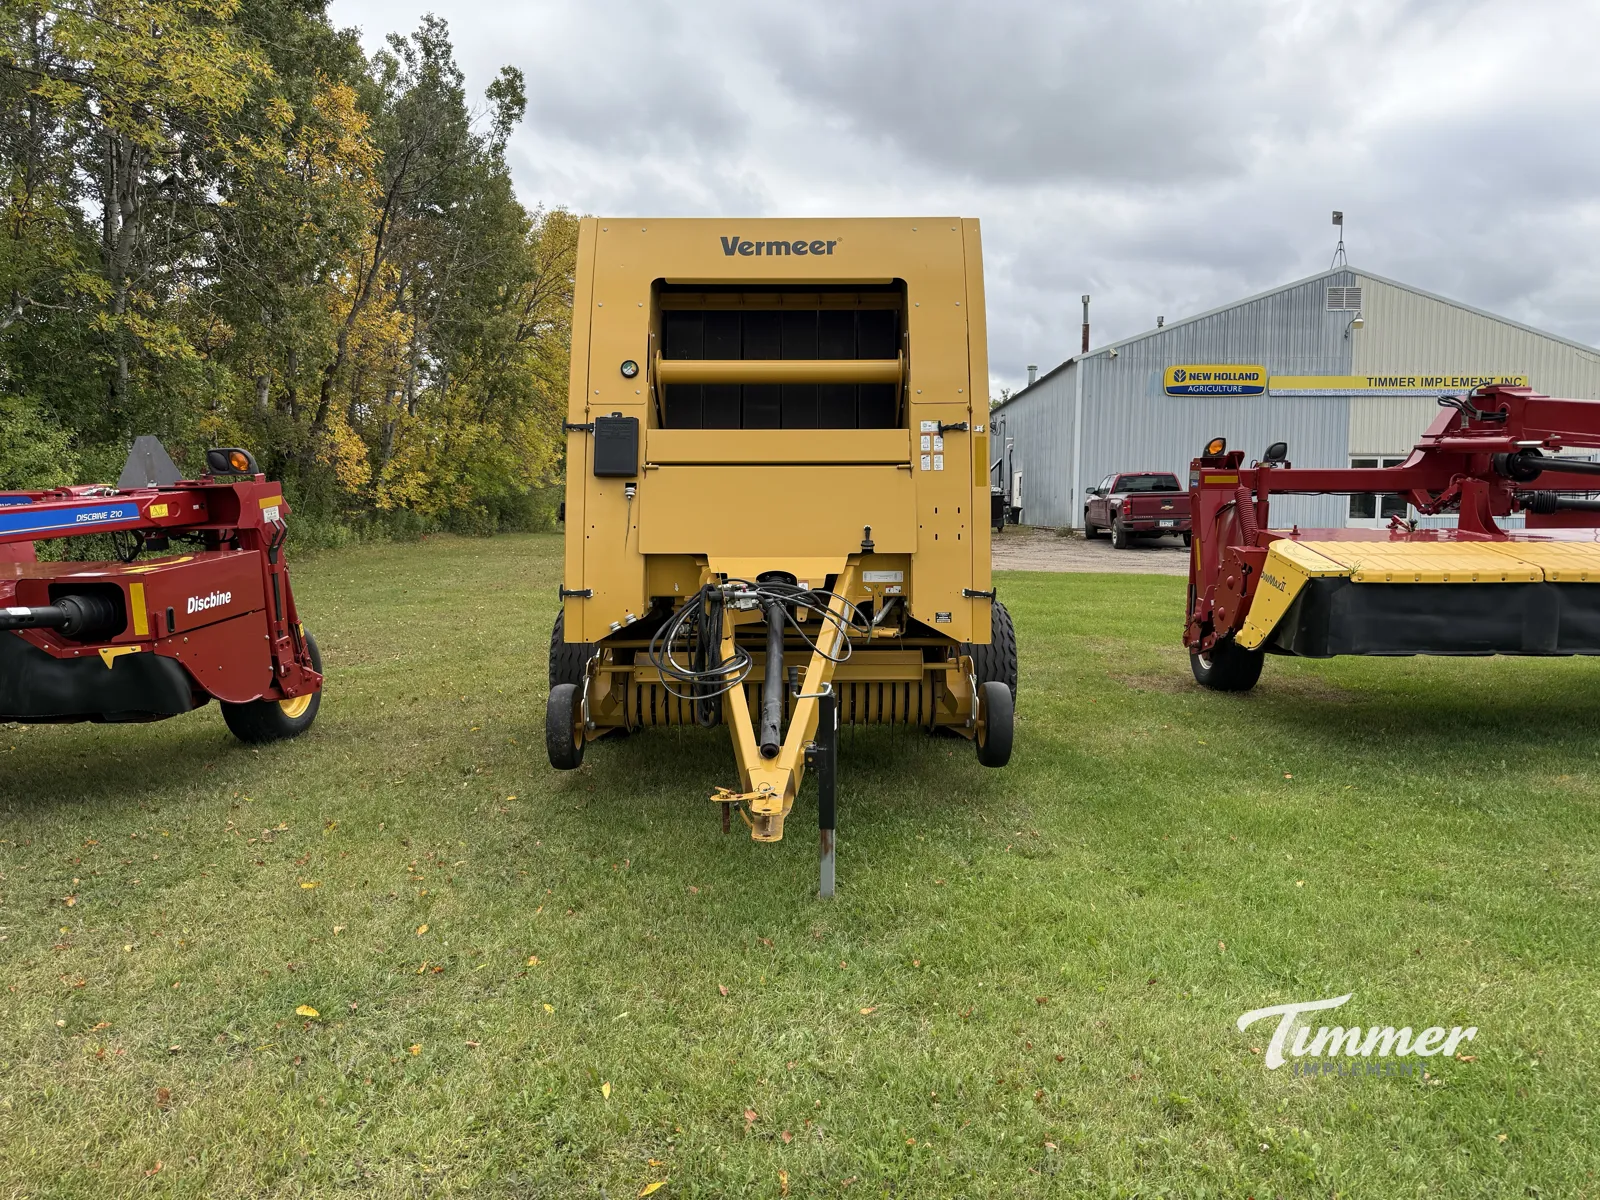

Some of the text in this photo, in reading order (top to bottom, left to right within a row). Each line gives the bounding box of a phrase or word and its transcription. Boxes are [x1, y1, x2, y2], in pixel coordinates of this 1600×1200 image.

[720, 236, 837, 256] Vermeer
[1189, 372, 1260, 381] NEW HOLLAND
[1367, 377, 1416, 387] TIMMER
[1420, 377, 1496, 387] IMPLEMENT
[1187, 385, 1243, 393] AGRICULTURE
[76, 510, 123, 522] DISCBINE 210
[187, 590, 232, 615] Discbine
